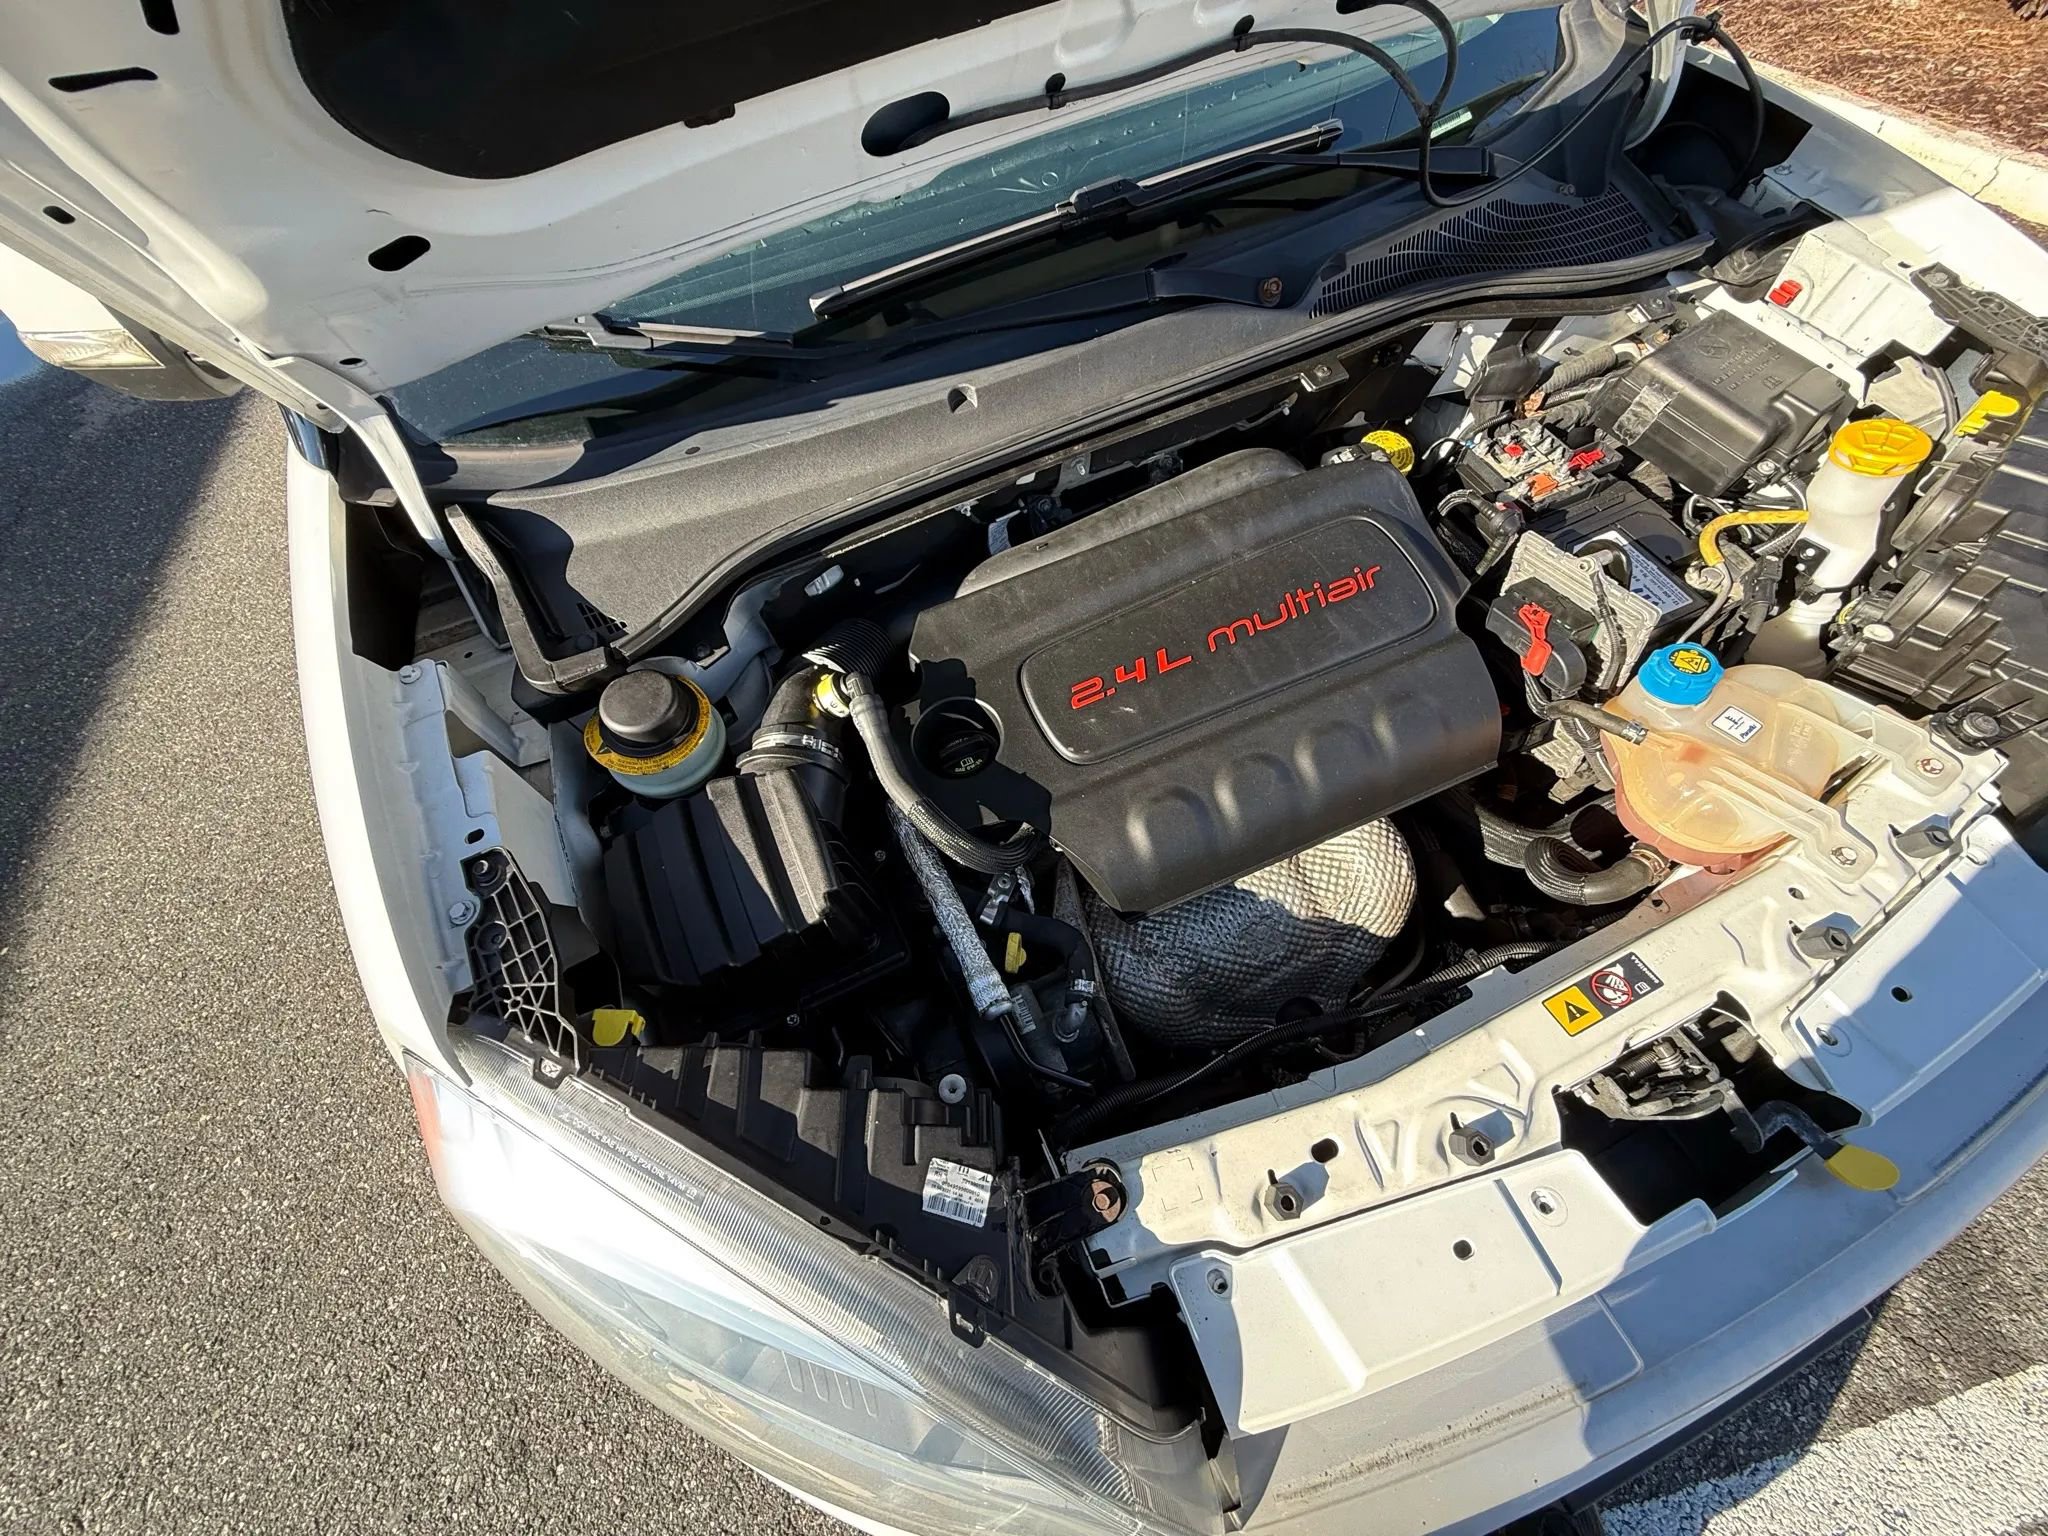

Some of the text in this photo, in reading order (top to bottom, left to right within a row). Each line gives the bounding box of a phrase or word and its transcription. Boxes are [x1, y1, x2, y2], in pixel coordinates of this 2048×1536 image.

[1206, 565, 1382, 652] multiair
[600, 1135, 616, 1148] SAE
[614, 1144, 627, 1155] HR
[650, 1166, 666, 1179] DRL
